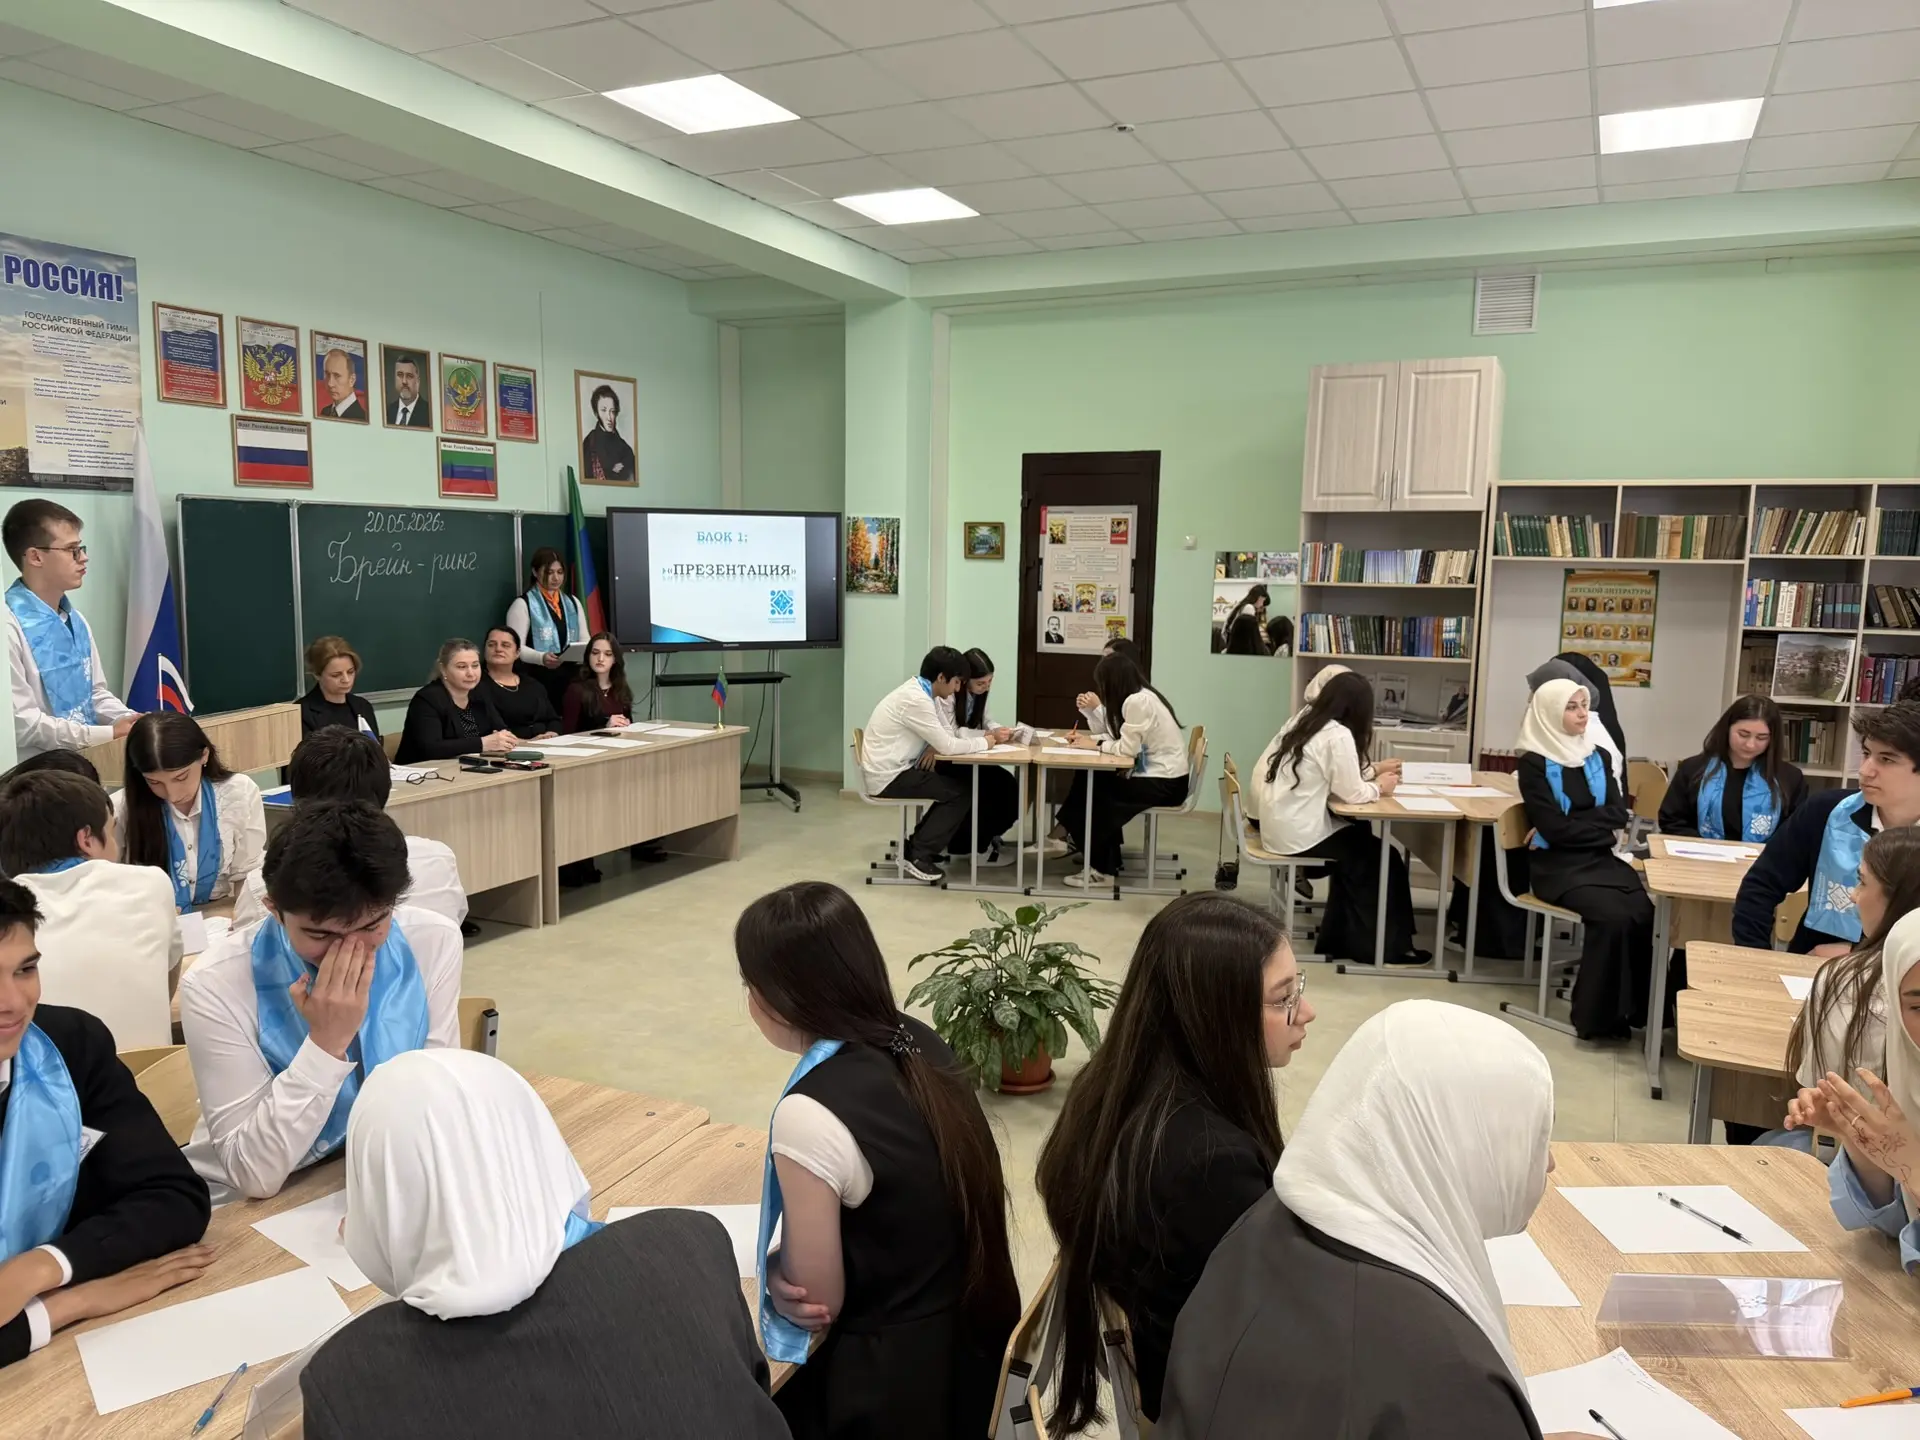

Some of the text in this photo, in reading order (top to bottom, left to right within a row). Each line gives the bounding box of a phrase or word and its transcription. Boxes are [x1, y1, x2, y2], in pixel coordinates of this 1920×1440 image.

[4, 254, 124, 302] РОССИЯ!
[22, 320, 131, 342] РОССИЙСКОЙ ФЕДЕРАЦИИ
[24, 311, 129, 332] ГОСУДАРСТВЕННЫЙ ГИМН
[696, 531, 733, 542] БЛОК
[328, 532, 412, 600] Брейн
